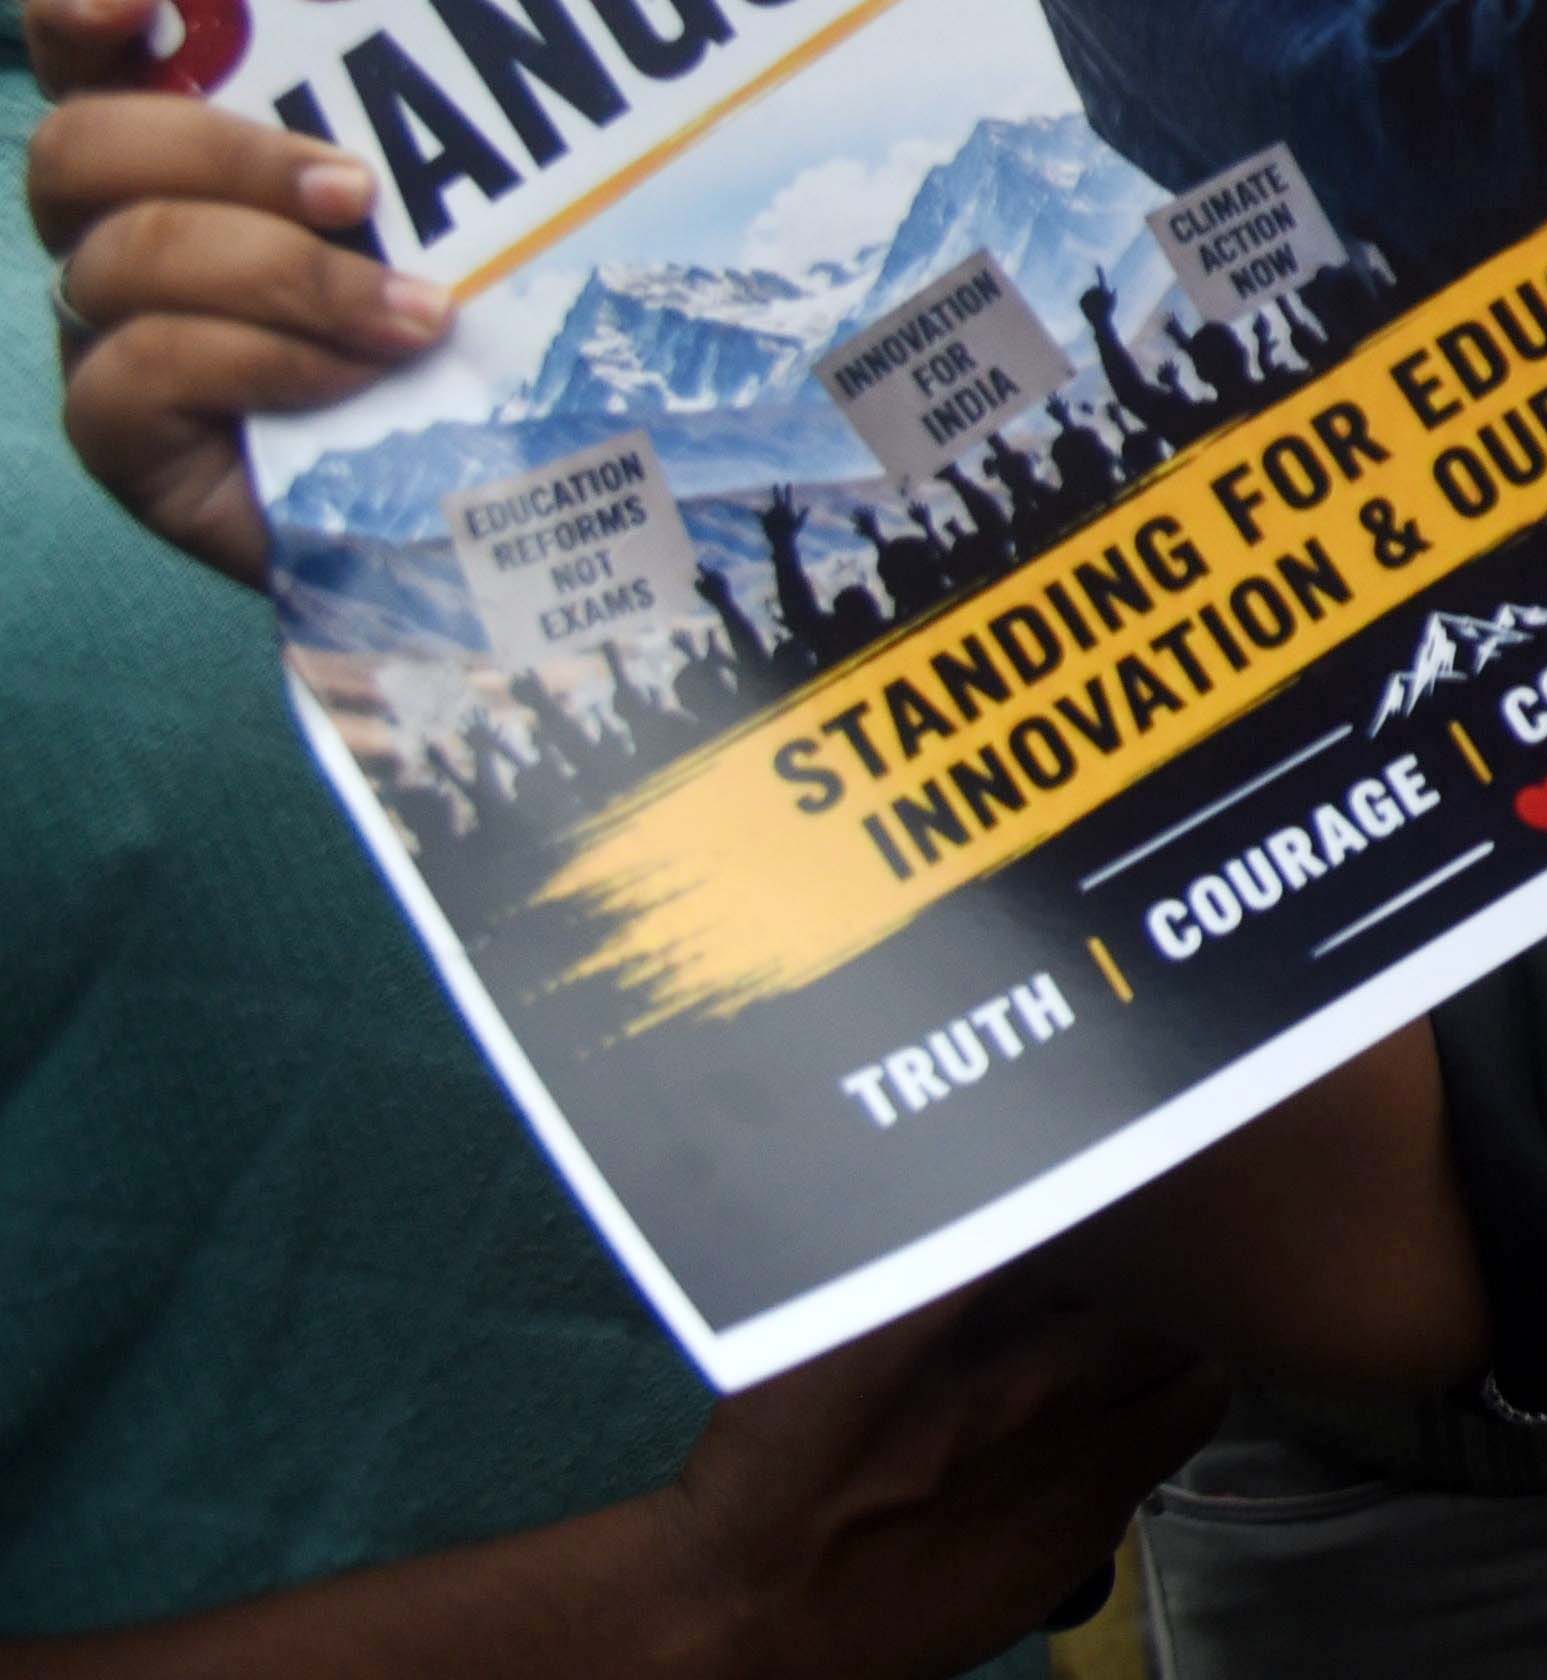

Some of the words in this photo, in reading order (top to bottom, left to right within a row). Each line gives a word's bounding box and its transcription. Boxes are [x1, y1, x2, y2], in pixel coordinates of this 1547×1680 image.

[1169, 161, 1289, 244] CLIMATE
[1199, 201, 1297, 275] ACTION
[1229, 242, 1298, 300] NOW
[833, 269, 1003, 402] INNOVATION
[912, 341, 977, 399] FOR
[921, 367, 1021, 448] INDIA
[464, 451, 646, 541] EDUCATION
[492, 494, 648, 571] REFORMS
[539, 576, 655, 642] EXAMS
[551, 549, 615, 595] NOT
[772, 494, 1209, 816] STANDING
[1210, 398, 1396, 545] FOR
[861, 537, 1356, 881] INNOVATION
[1357, 496, 1432, 570] &
[840, 969, 1076, 1128] TRUTH
[1144, 753, 1441, 962] COURAGE
